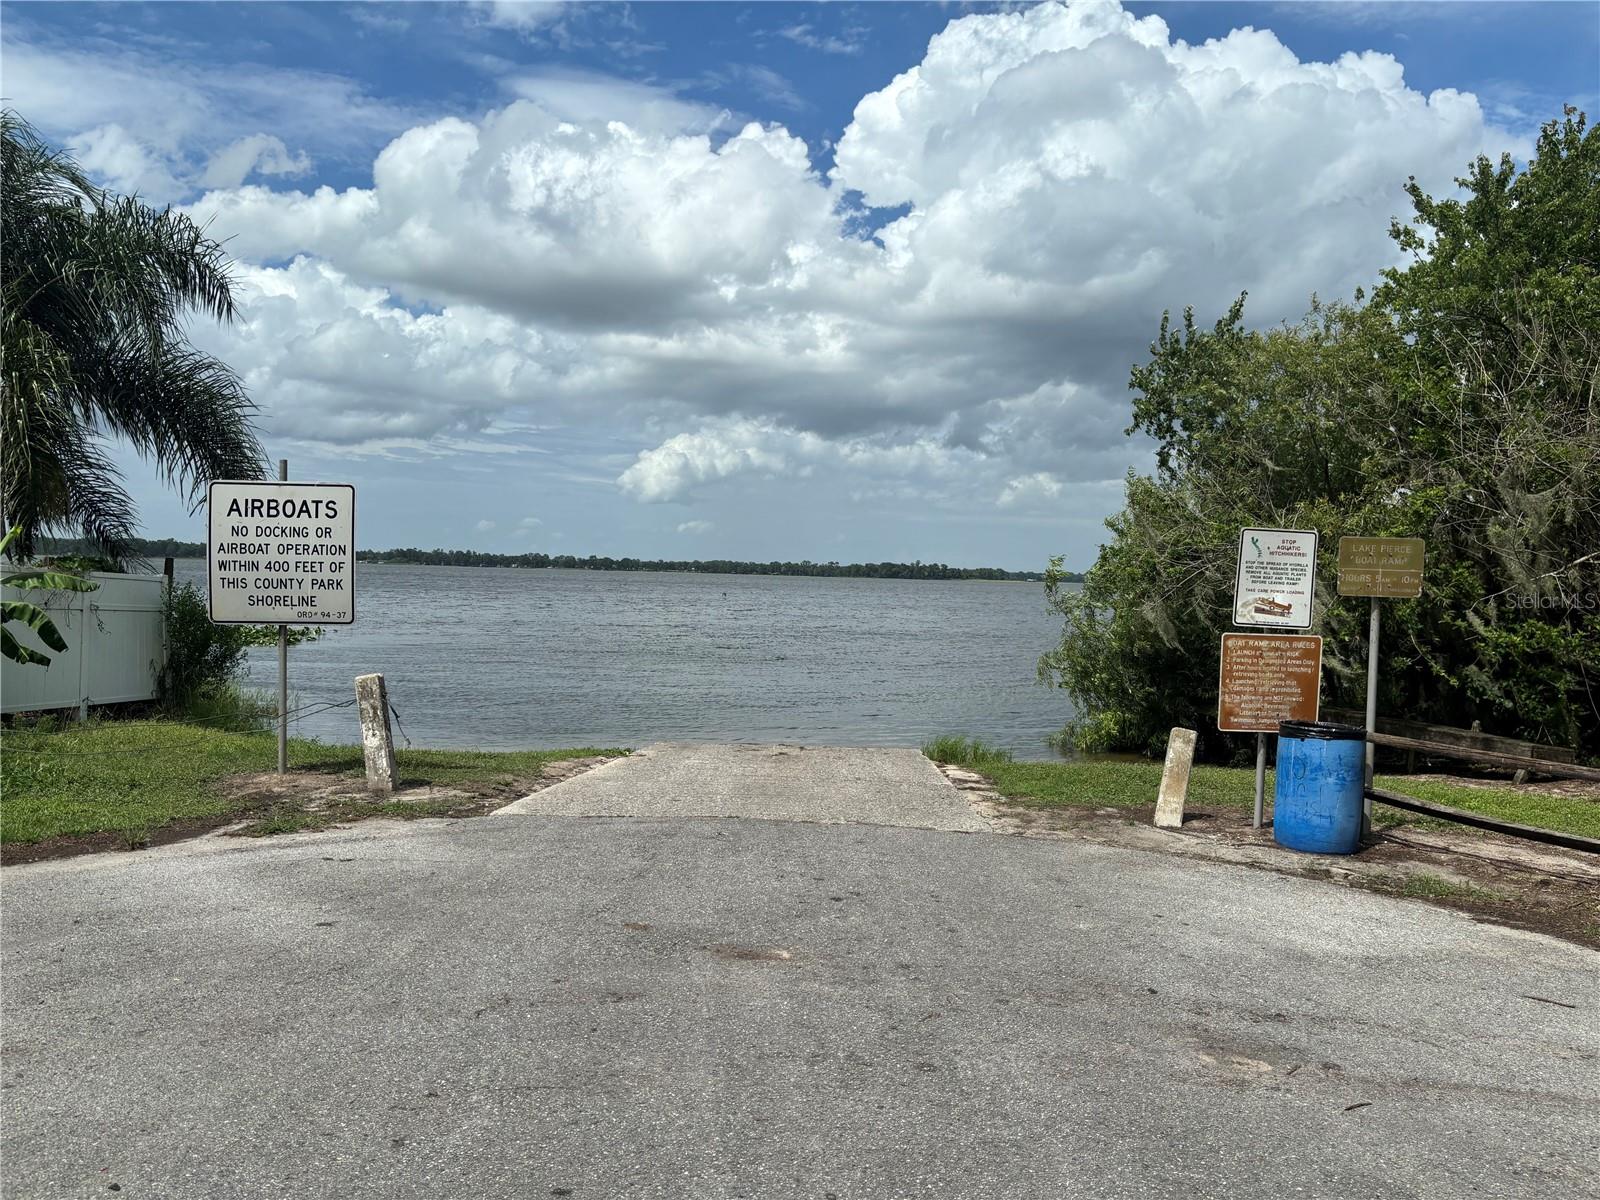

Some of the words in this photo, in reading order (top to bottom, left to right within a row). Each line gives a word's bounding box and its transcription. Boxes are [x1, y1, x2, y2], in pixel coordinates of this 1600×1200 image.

[226, 498, 338, 519] AIRBOATS
[231, 525, 248, 537] NO
[255, 526, 309, 538] DOCKING
[315, 527, 332, 538] OR
[217, 543, 270, 554] AIRBOAT
[277, 544, 346, 555] OPERATION
[1352, 544, 1376, 552] LAKE
[1381, 545, 1412, 553] PIERCE
[218, 560, 259, 571] WITHIN
[264, 561, 289, 572] 400
[295, 562, 324, 572] FEET
[329, 562, 345, 573] OF
[220, 578, 247, 589] THIS
[254, 578, 304, 589] COUNTY
[311, 579, 343, 590] PARK
[248, 595, 317, 607] SHORELINE
